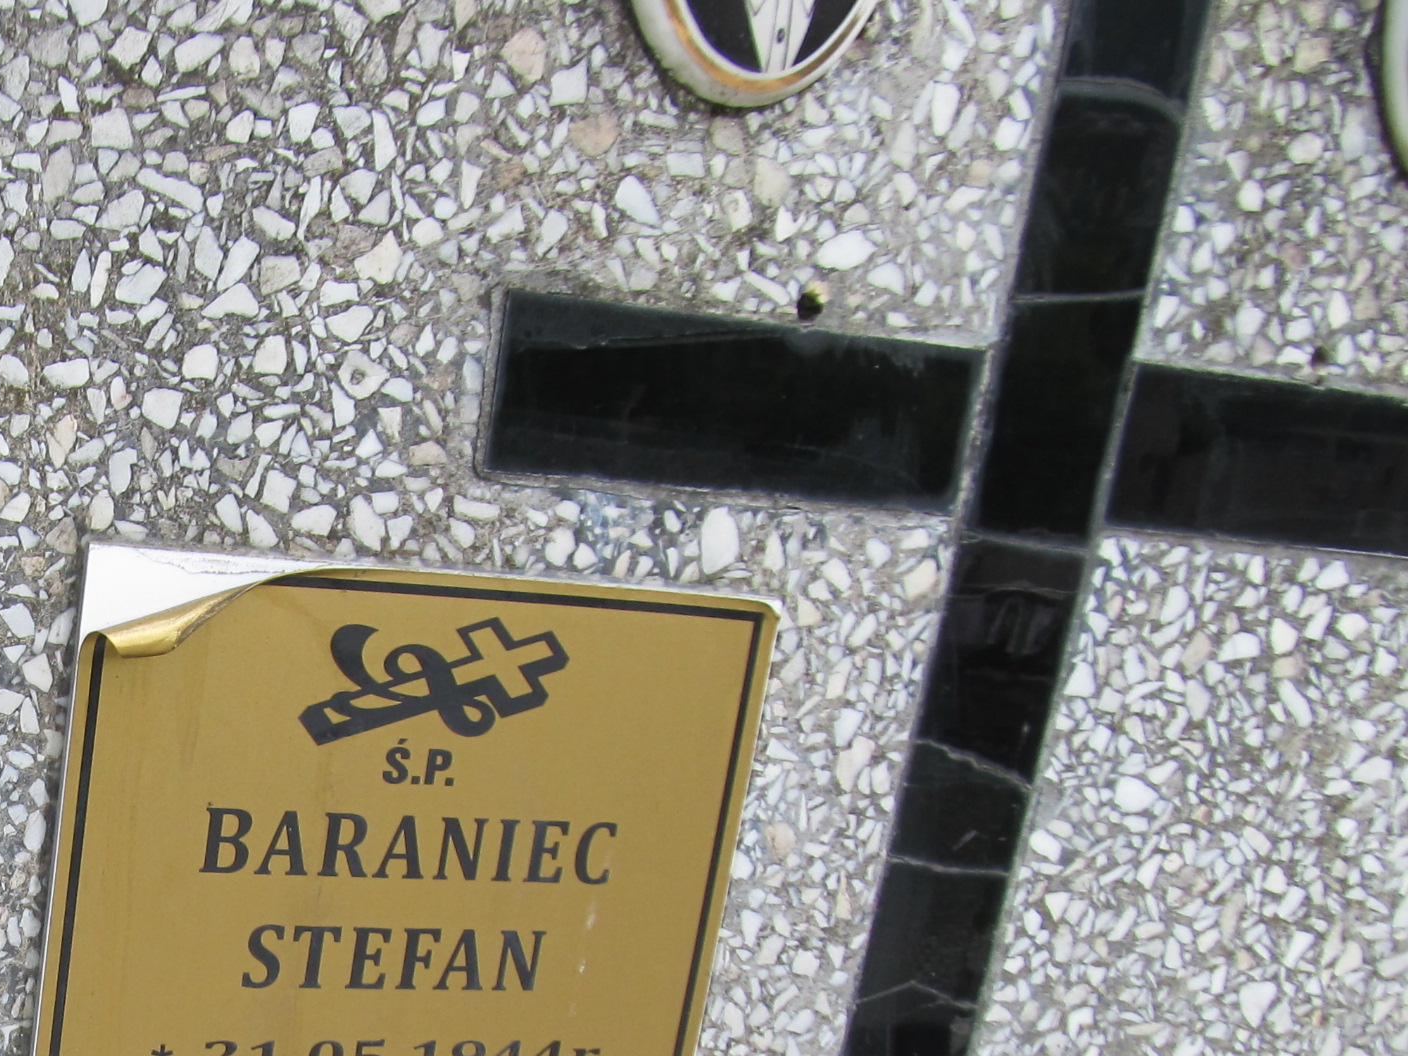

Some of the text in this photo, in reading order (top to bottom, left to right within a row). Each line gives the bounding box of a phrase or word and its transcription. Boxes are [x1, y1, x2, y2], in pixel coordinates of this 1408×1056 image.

[382, 738, 455, 787] Ś.P.
[199, 806, 618, 885] BARANIEC
[241, 924, 547, 992] STEFAN
